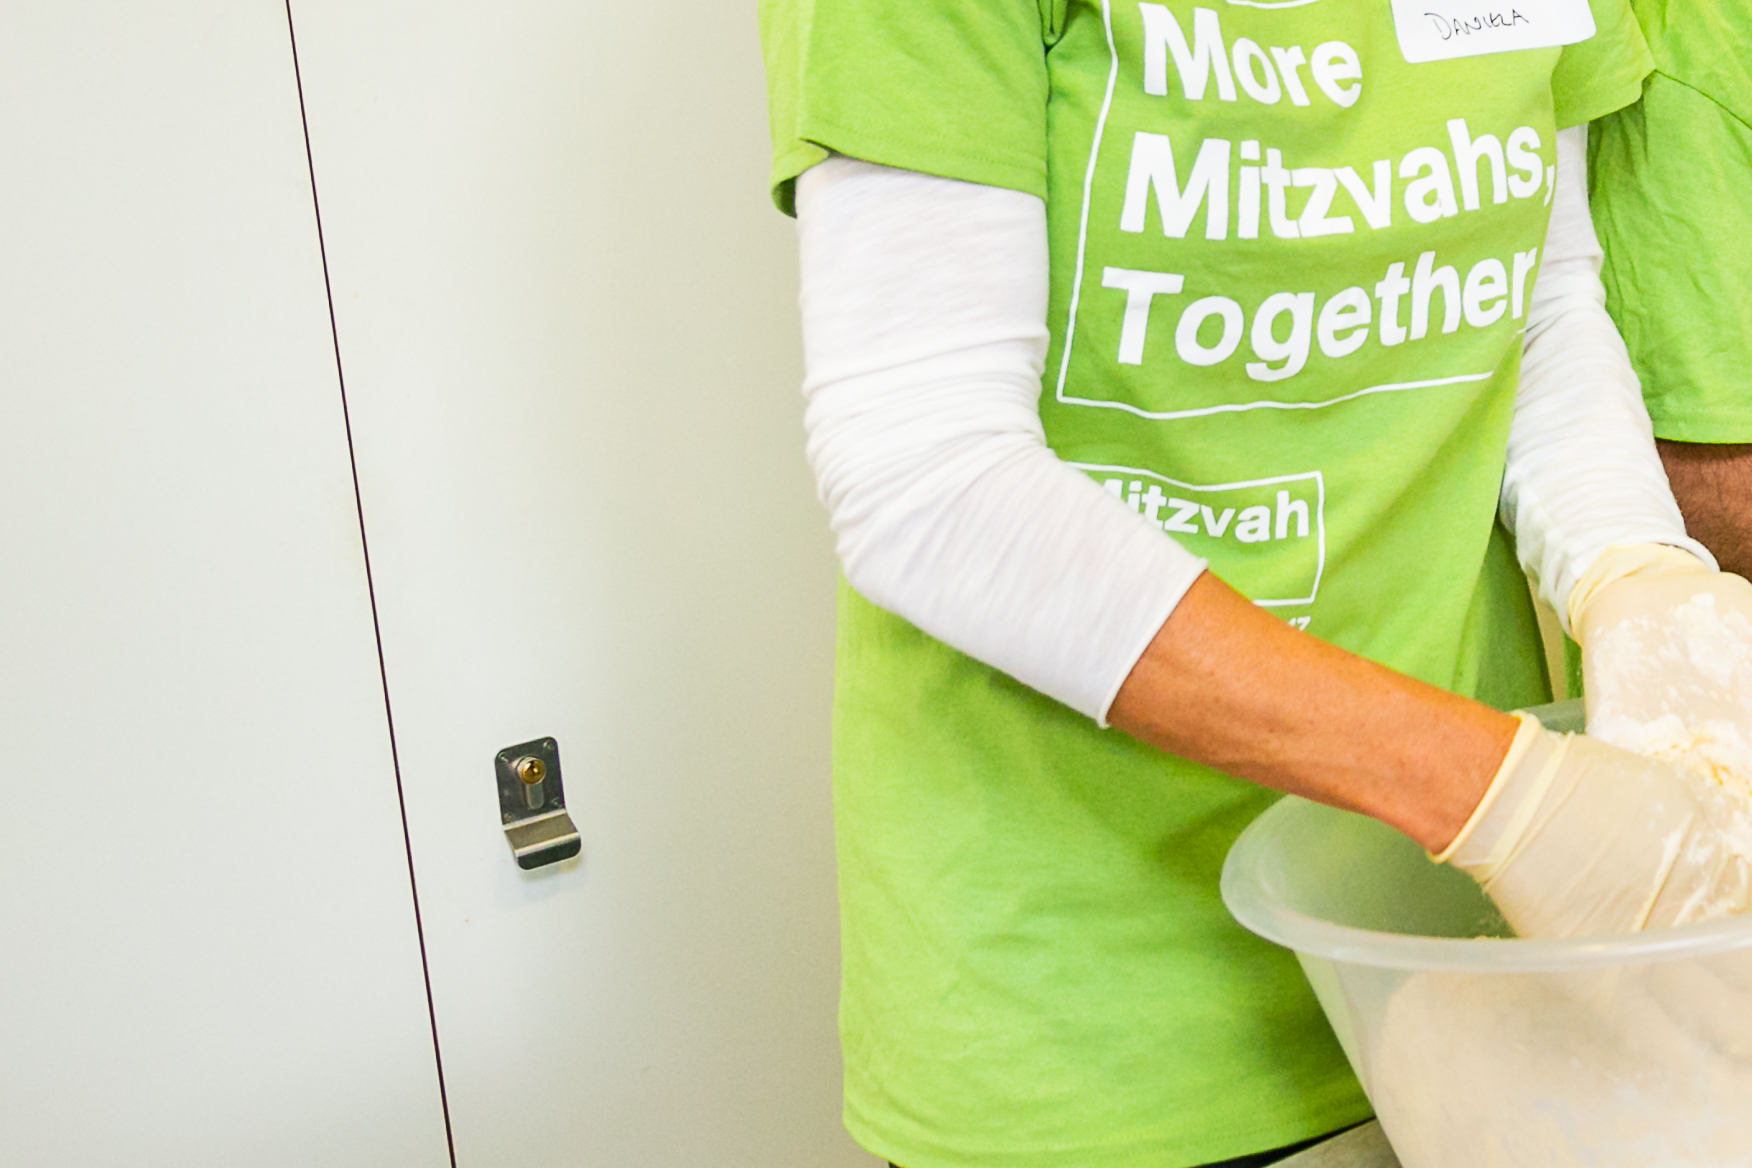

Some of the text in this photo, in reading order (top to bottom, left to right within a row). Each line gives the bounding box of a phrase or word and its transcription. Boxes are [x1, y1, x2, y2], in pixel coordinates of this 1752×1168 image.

[1138, 1, 1364, 109] More
[1423, 8, 1530, 40] DANIELA
[1119, 117, 1556, 241] Mitzvahs,
[1101, 247, 1539, 383] Together
[1104, 478, 1310, 543] itzvah
